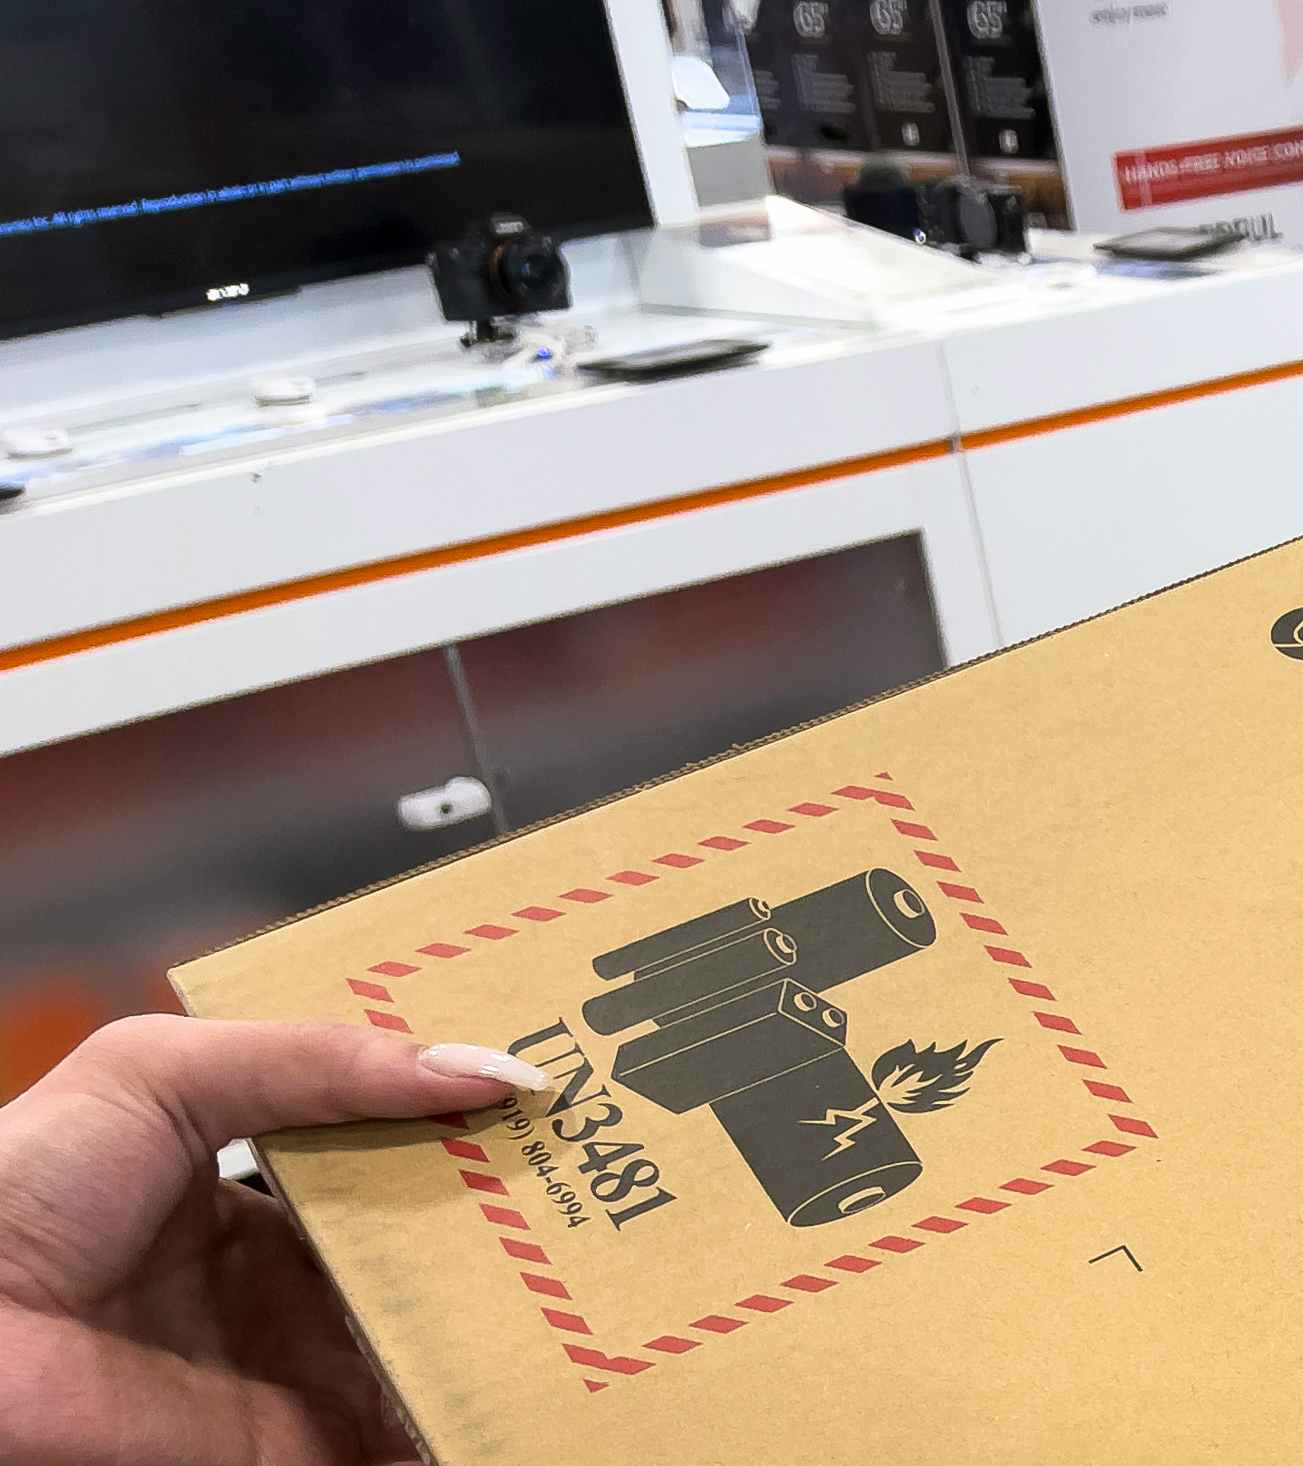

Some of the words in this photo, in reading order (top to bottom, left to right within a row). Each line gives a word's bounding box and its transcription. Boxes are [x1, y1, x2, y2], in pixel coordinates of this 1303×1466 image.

[497, 1093, 536, 1141] 919)
[521, 1141, 593, 1229] 804-6994
[506, 1016, 678, 1232] UN3481
